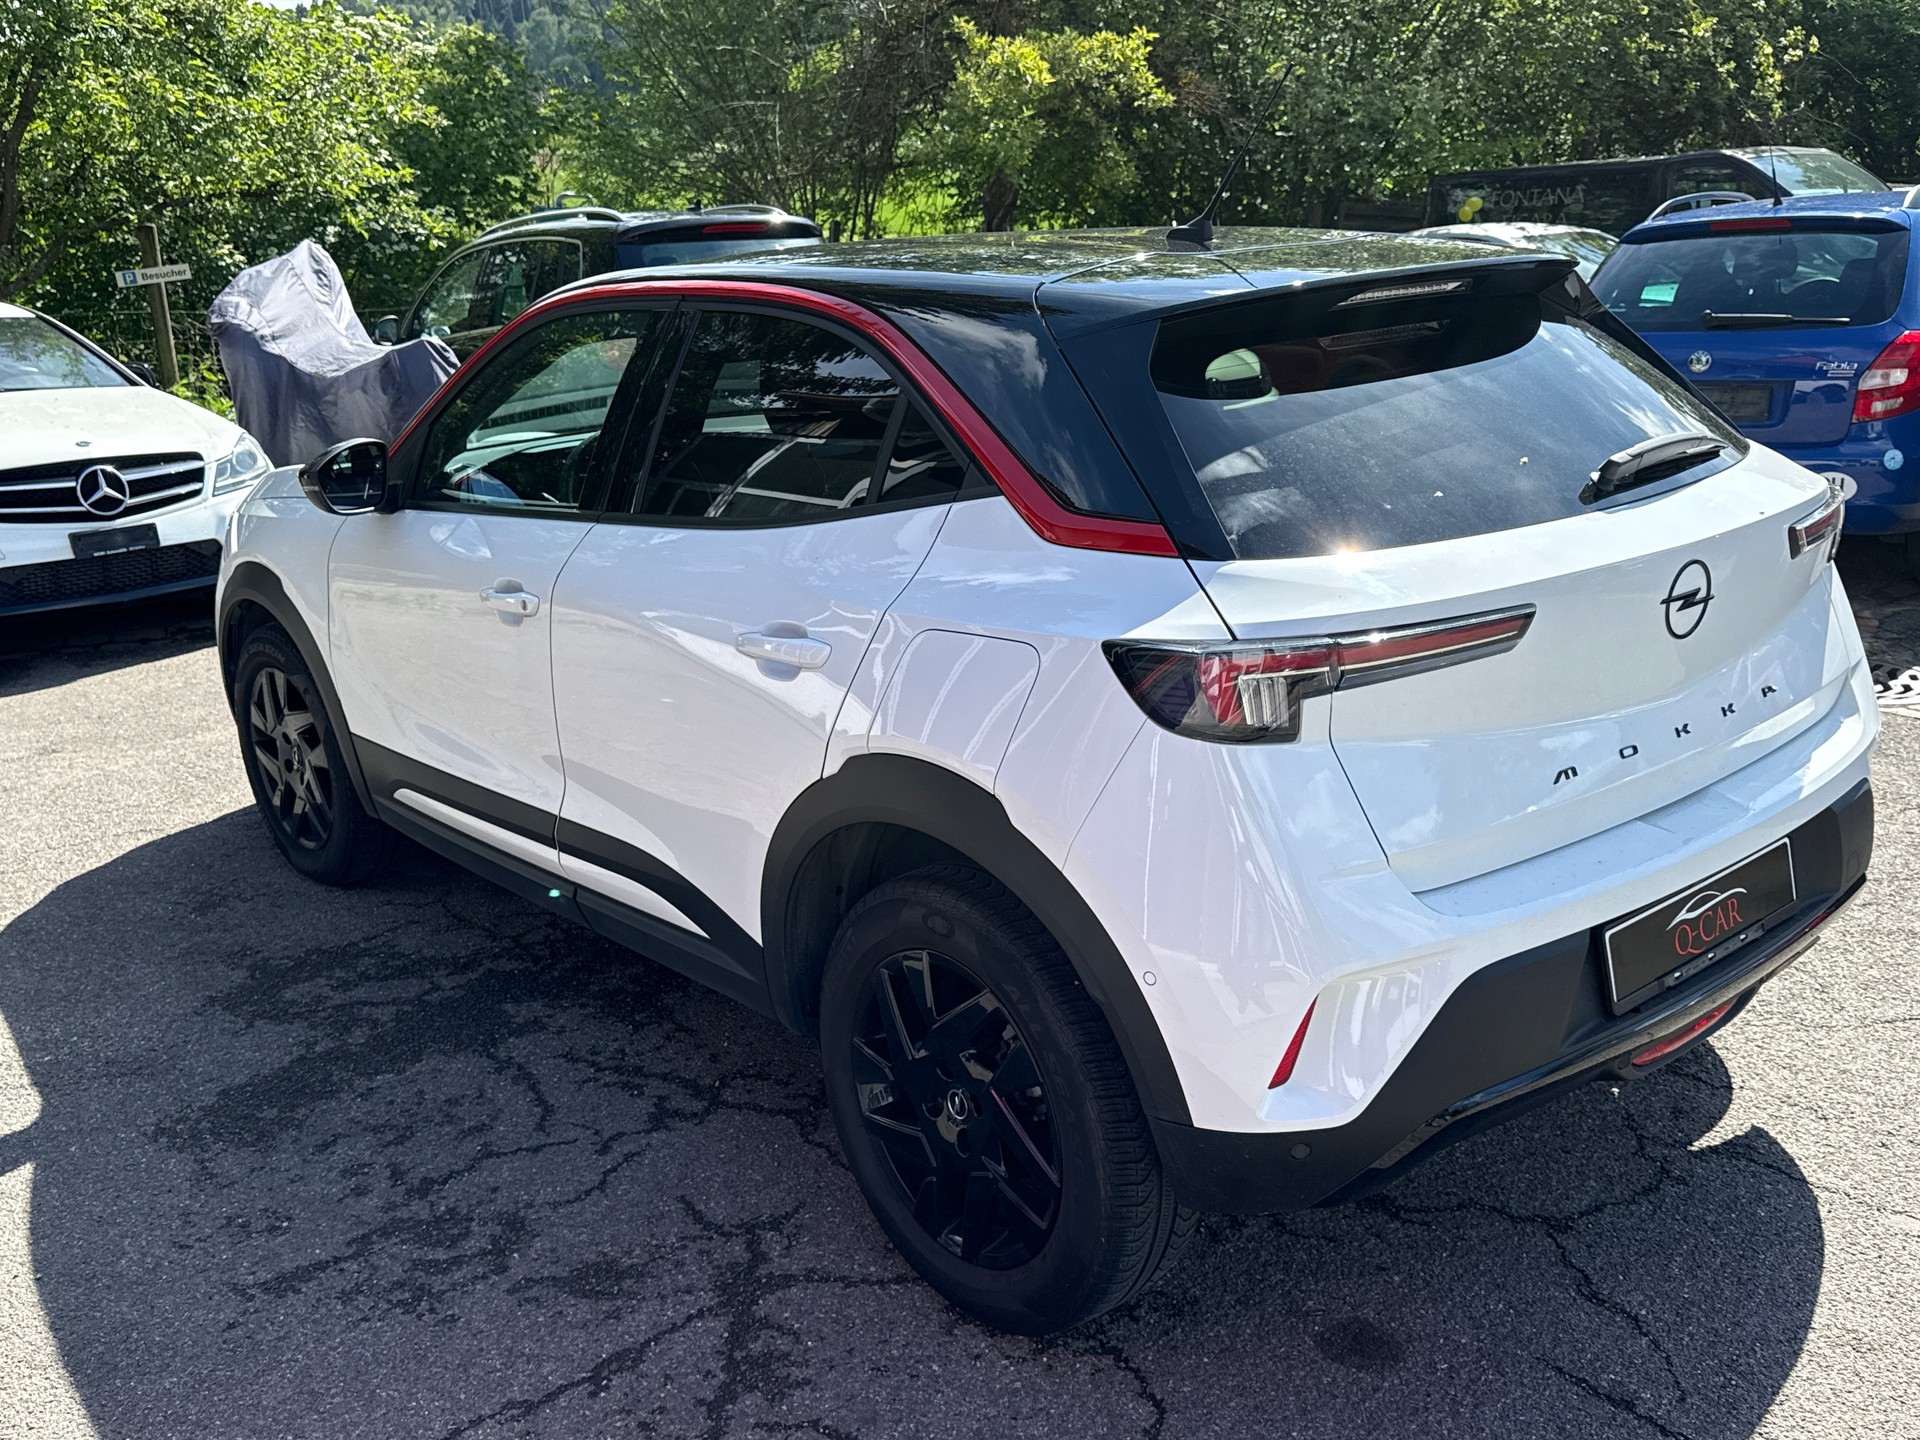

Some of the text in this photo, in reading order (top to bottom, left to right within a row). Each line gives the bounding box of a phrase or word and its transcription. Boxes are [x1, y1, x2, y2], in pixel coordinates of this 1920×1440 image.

[1491, 184, 1585, 208] FONTANA
[141, 269, 187, 281] Besucher
[1815, 361, 1858, 370] Fabia
[1553, 684, 1777, 785] MOKKA
[1675, 898, 1743, 955] Q-CAR
